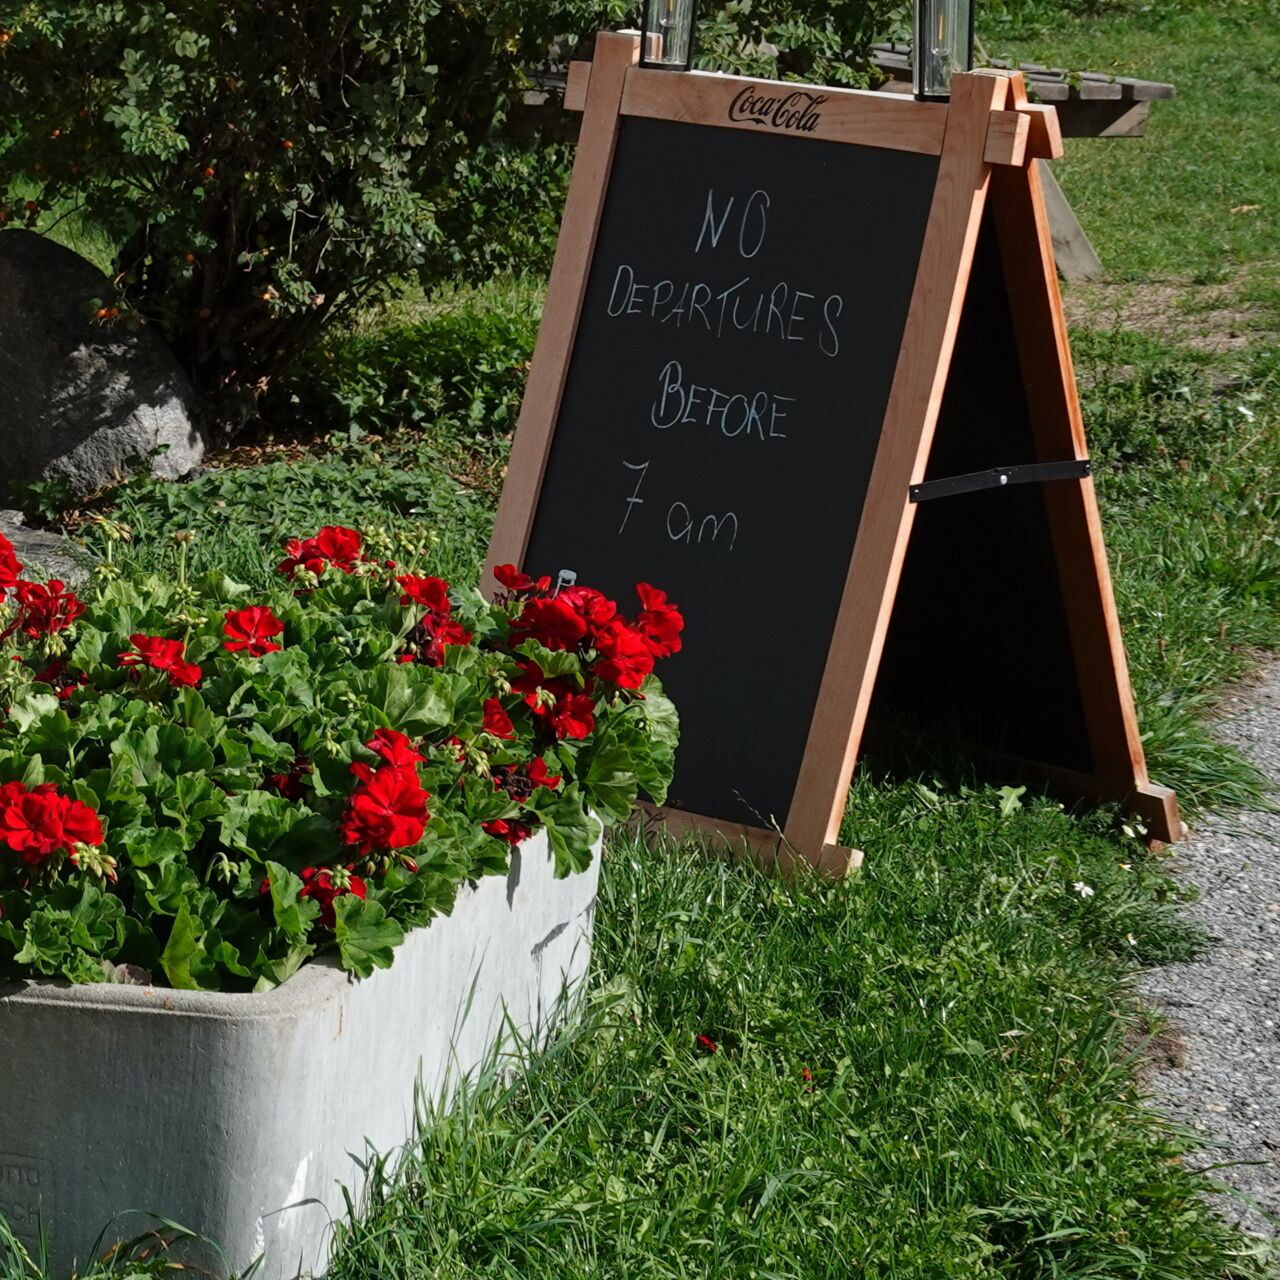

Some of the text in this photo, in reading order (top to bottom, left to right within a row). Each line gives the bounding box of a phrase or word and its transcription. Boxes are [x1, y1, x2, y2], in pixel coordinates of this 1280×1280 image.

[728, 85, 829, 133] Coca-Cola
[694, 189, 770, 258] NO
[607, 265, 843, 357] DEPARTURES
[651, 360, 796, 440] BEFORE
[618, 460, 739, 551] 7 am
